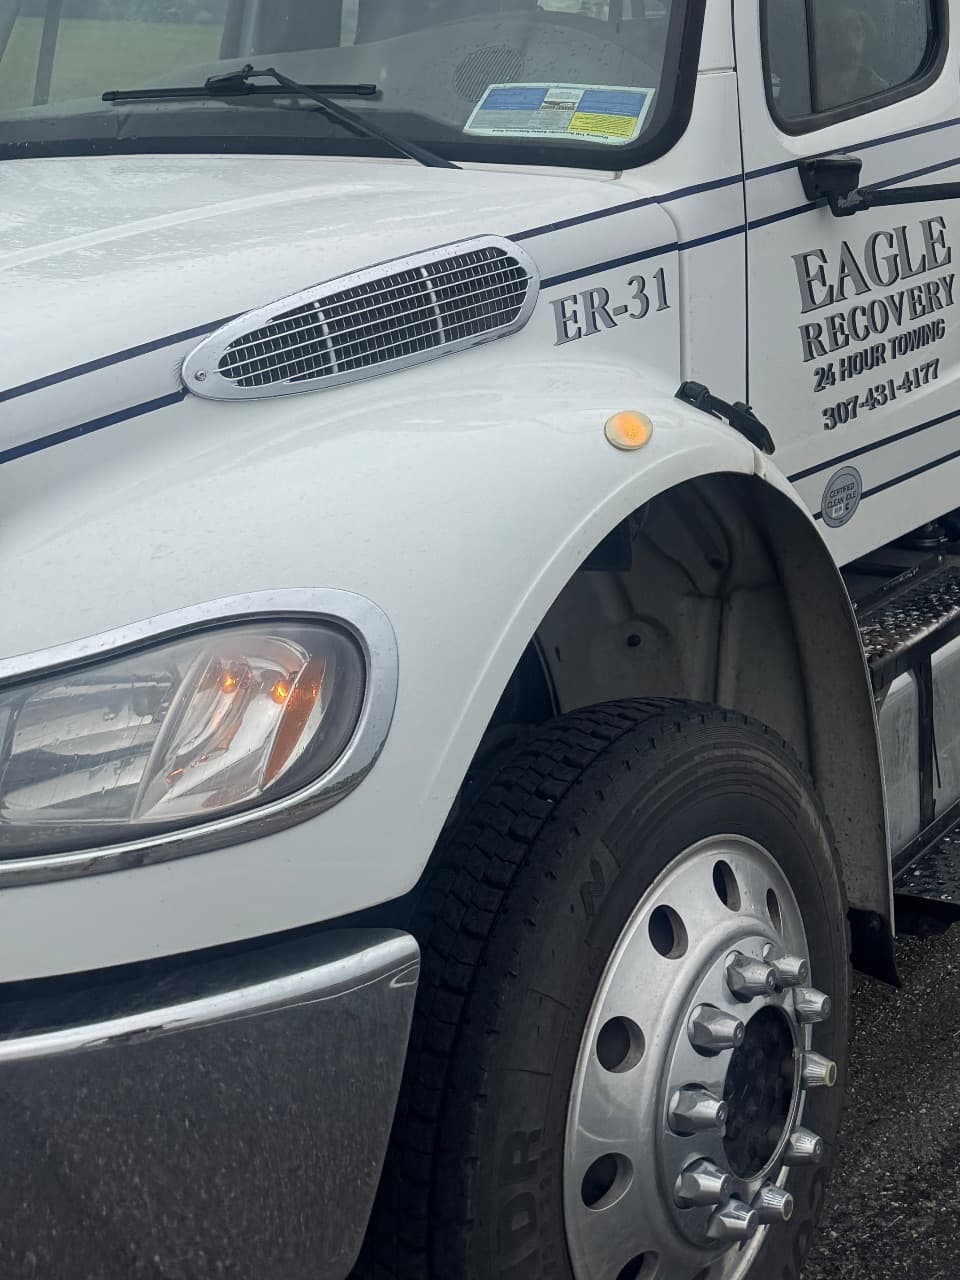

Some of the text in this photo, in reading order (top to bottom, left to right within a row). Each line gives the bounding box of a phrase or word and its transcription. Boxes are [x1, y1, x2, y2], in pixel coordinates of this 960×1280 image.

[789, 215, 952, 314] EAGLE
[548, 267, 672, 346] ER-31
[798, 273, 955, 363] RECOVERY
[813, 318, 946, 393] 24 HOUR TOWING
[821, 357, 940, 431] 307-431-4177
[827, 495, 845, 510] CLEAN
